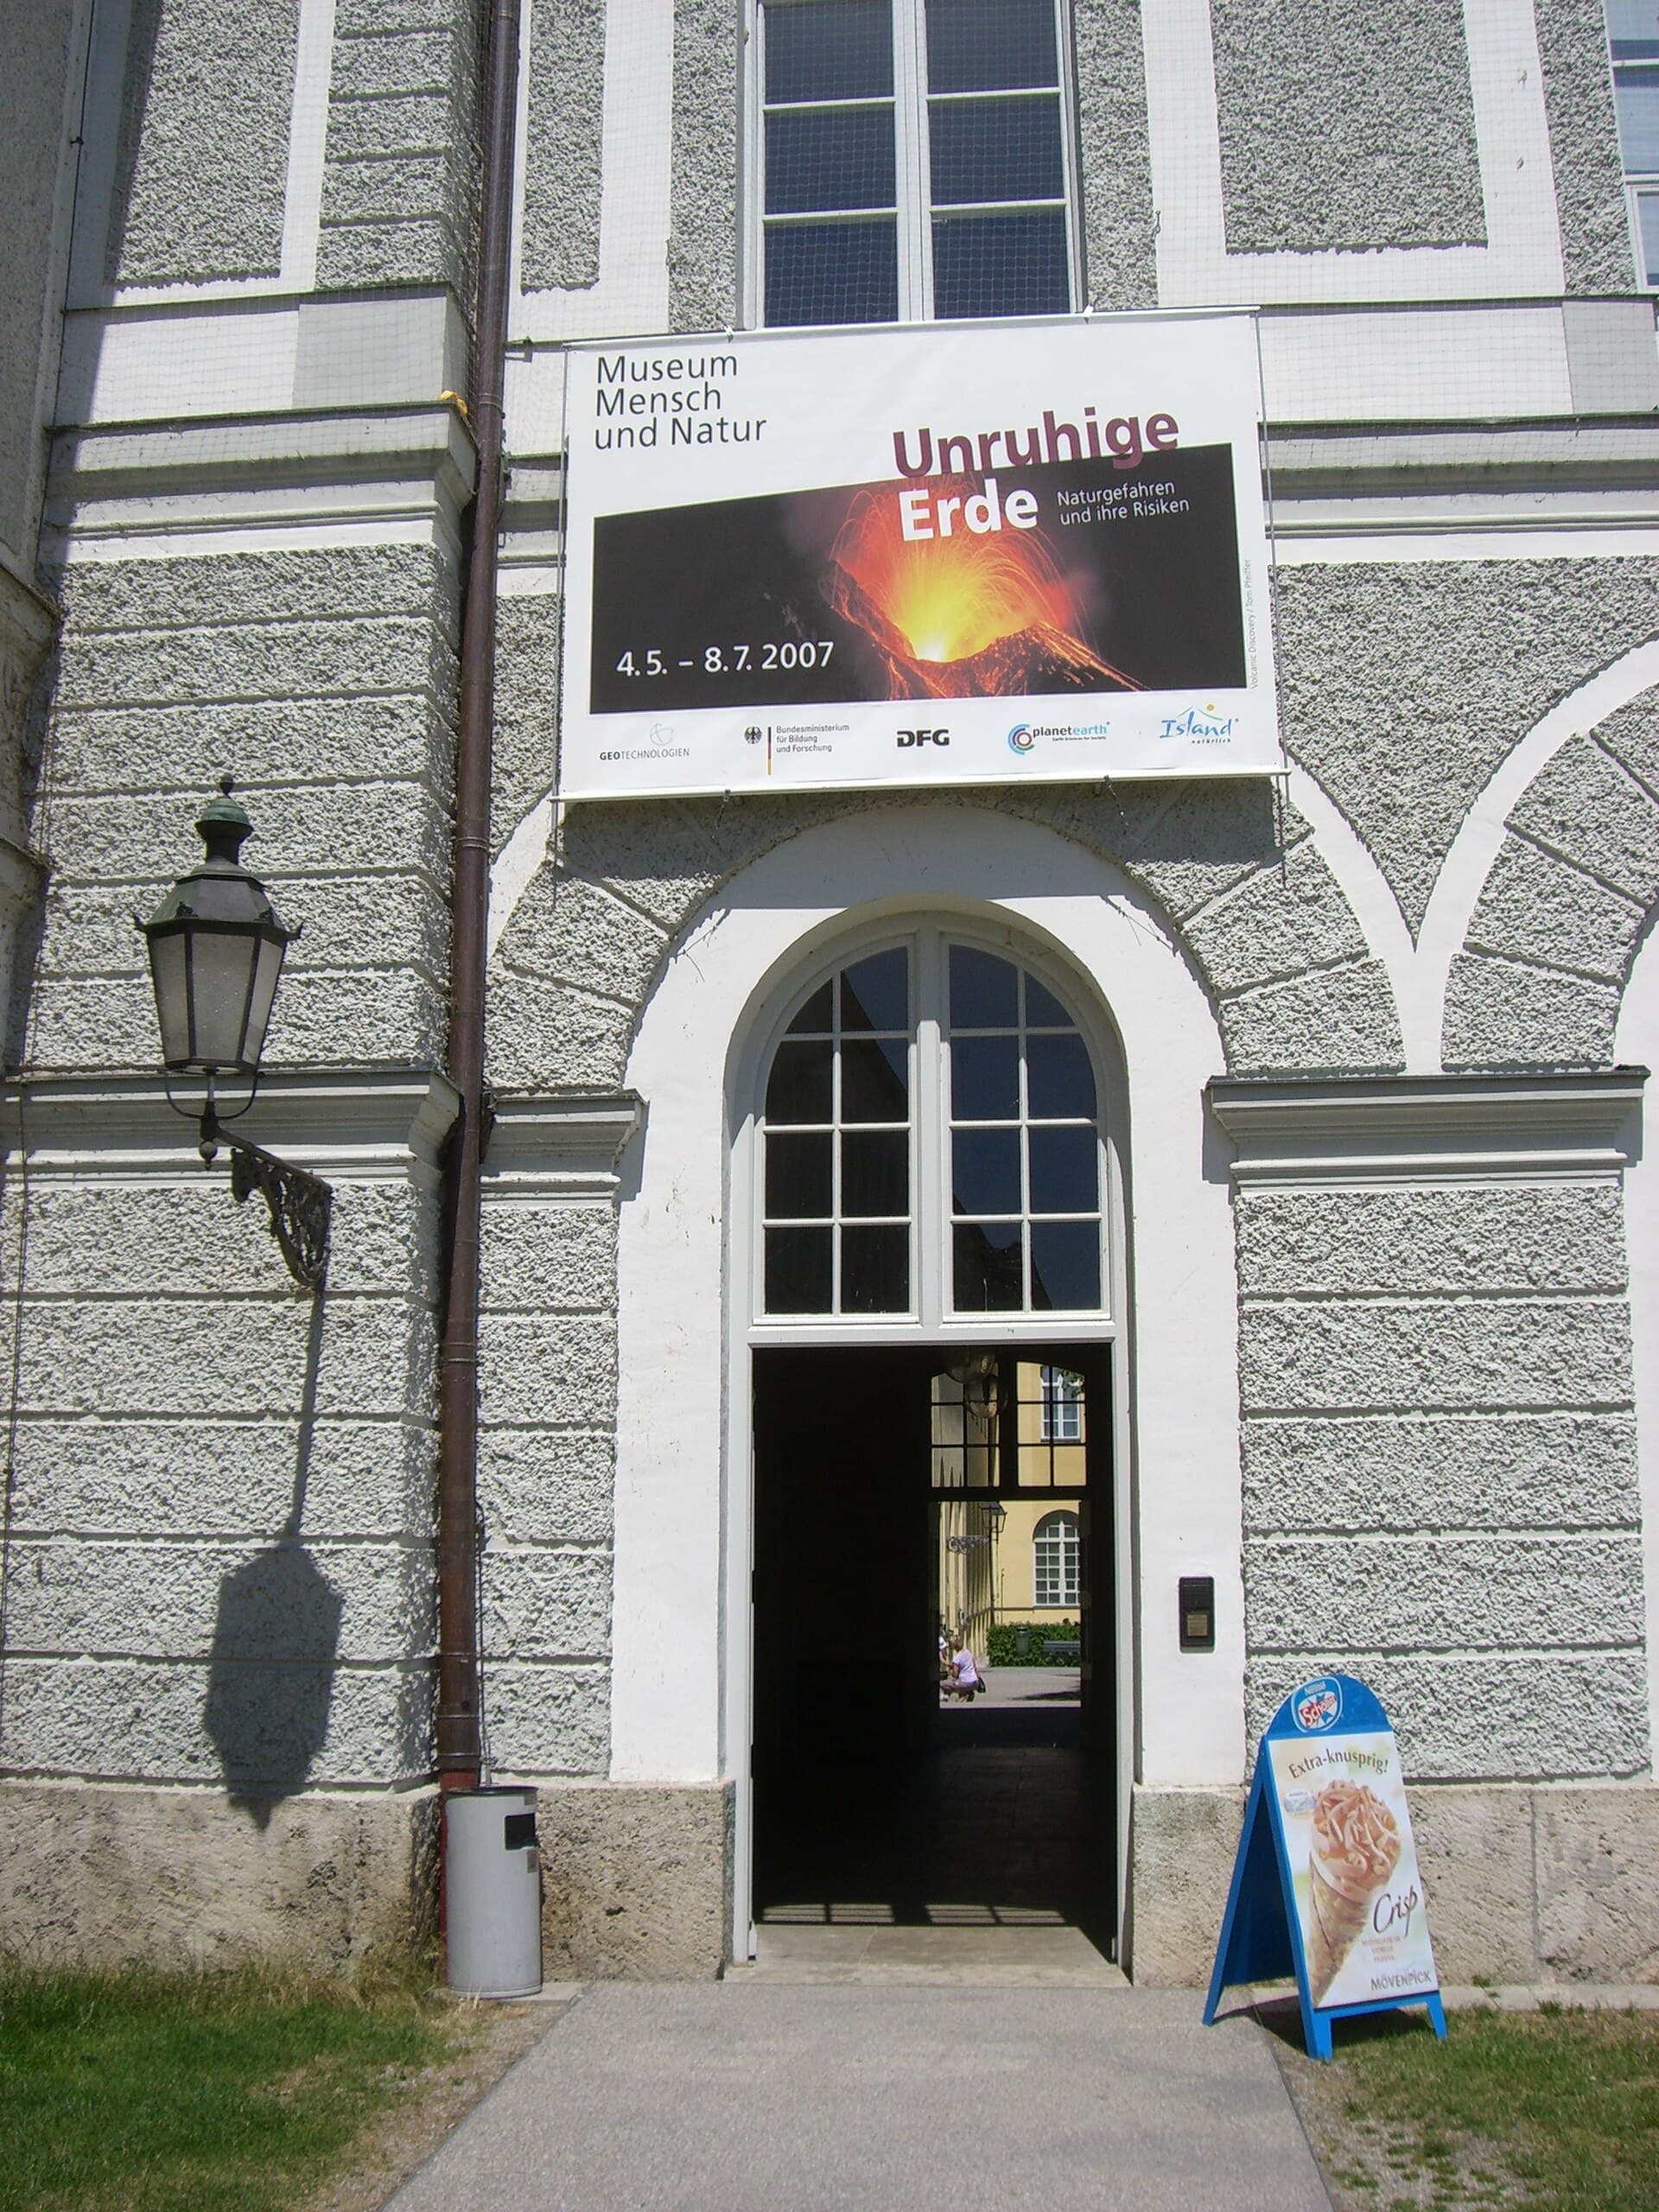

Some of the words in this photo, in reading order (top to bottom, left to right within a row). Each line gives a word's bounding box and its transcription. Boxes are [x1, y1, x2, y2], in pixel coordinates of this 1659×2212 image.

[597, 355, 738, 384] Museum
[596, 381, 721, 416] Mensch
[594, 416, 658, 449] und
[671, 416, 767, 445] Natur
[893, 406, 1179, 478] Unruhige
[1057, 480, 1175, 507] Naturgefahren
[898, 478, 1039, 542] Erde
[1059, 507, 1092, 525] und
[1096, 504, 1128, 522] ihre
[1133, 498, 1190, 518] Risiken
[1245, 590, 1254, 607] Tom
[1247, 614, 1257, 653] Discovery
[760, 641, 835, 671] 2007
[776, 724, 850, 734] Bundesministerium
[788, 734, 818, 743] Bildung
[897, 728, 950, 748] DFG
[1159, 711, 1232, 739] Island
[599, 747, 690, 761] GEOTECHNOLOGIEN
[792, 744, 833, 753] Forschung
[1288, 1748, 1389, 1779] Extra-knusprig!
[1373, 1884, 1418, 1937] Crisp
[1370, 1969, 1432, 1991] MÖVENPICK
